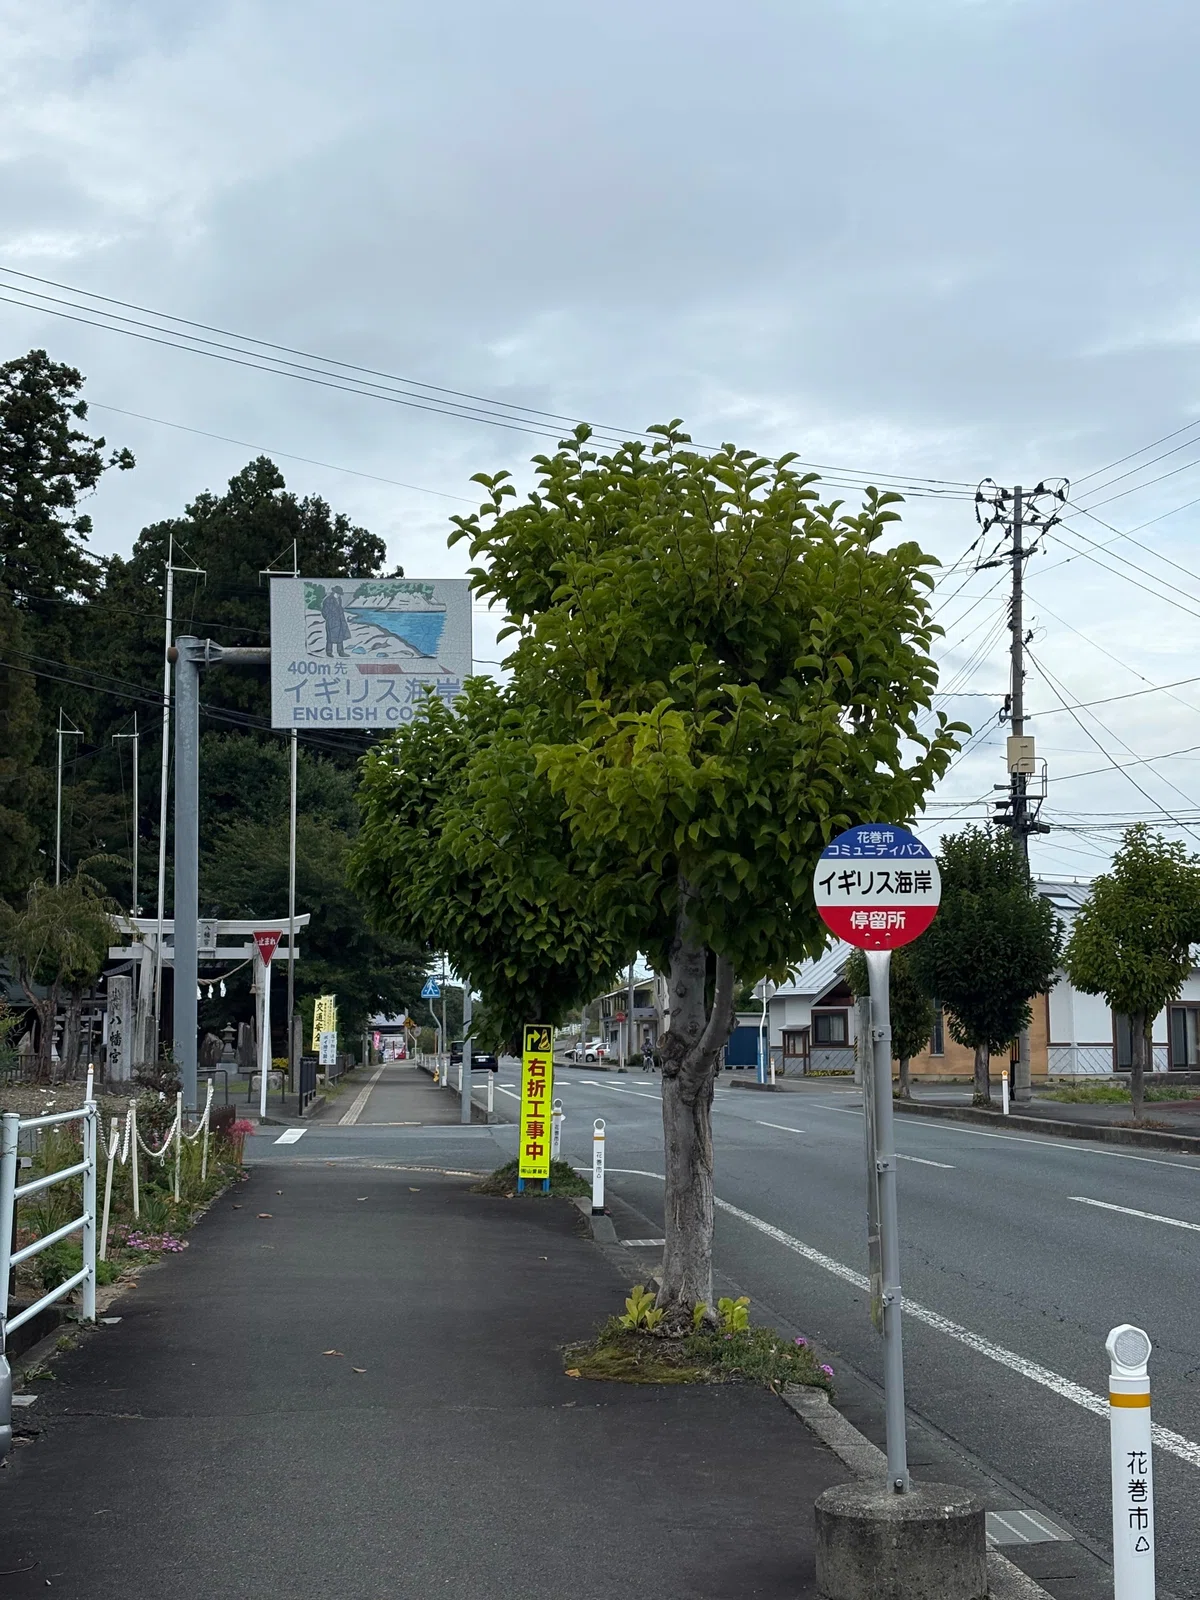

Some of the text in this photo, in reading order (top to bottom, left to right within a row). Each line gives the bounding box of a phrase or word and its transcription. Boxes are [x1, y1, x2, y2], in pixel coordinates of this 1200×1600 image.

[284, 677, 461, 705] イギリス海岸
[293, 706, 377, 721] ENGLISH
[856, 831, 895, 844] 花巻市
[828, 843, 925, 857] コミュニティバス
[819, 869, 932, 896] イギリス海岸
[850, 910, 906, 930] 停留所
[258, 937, 276, 946] 止まれ
[525, 1057, 547, 1161] 右折工事中
[1126, 1450, 1150, 1531] 花巻市
